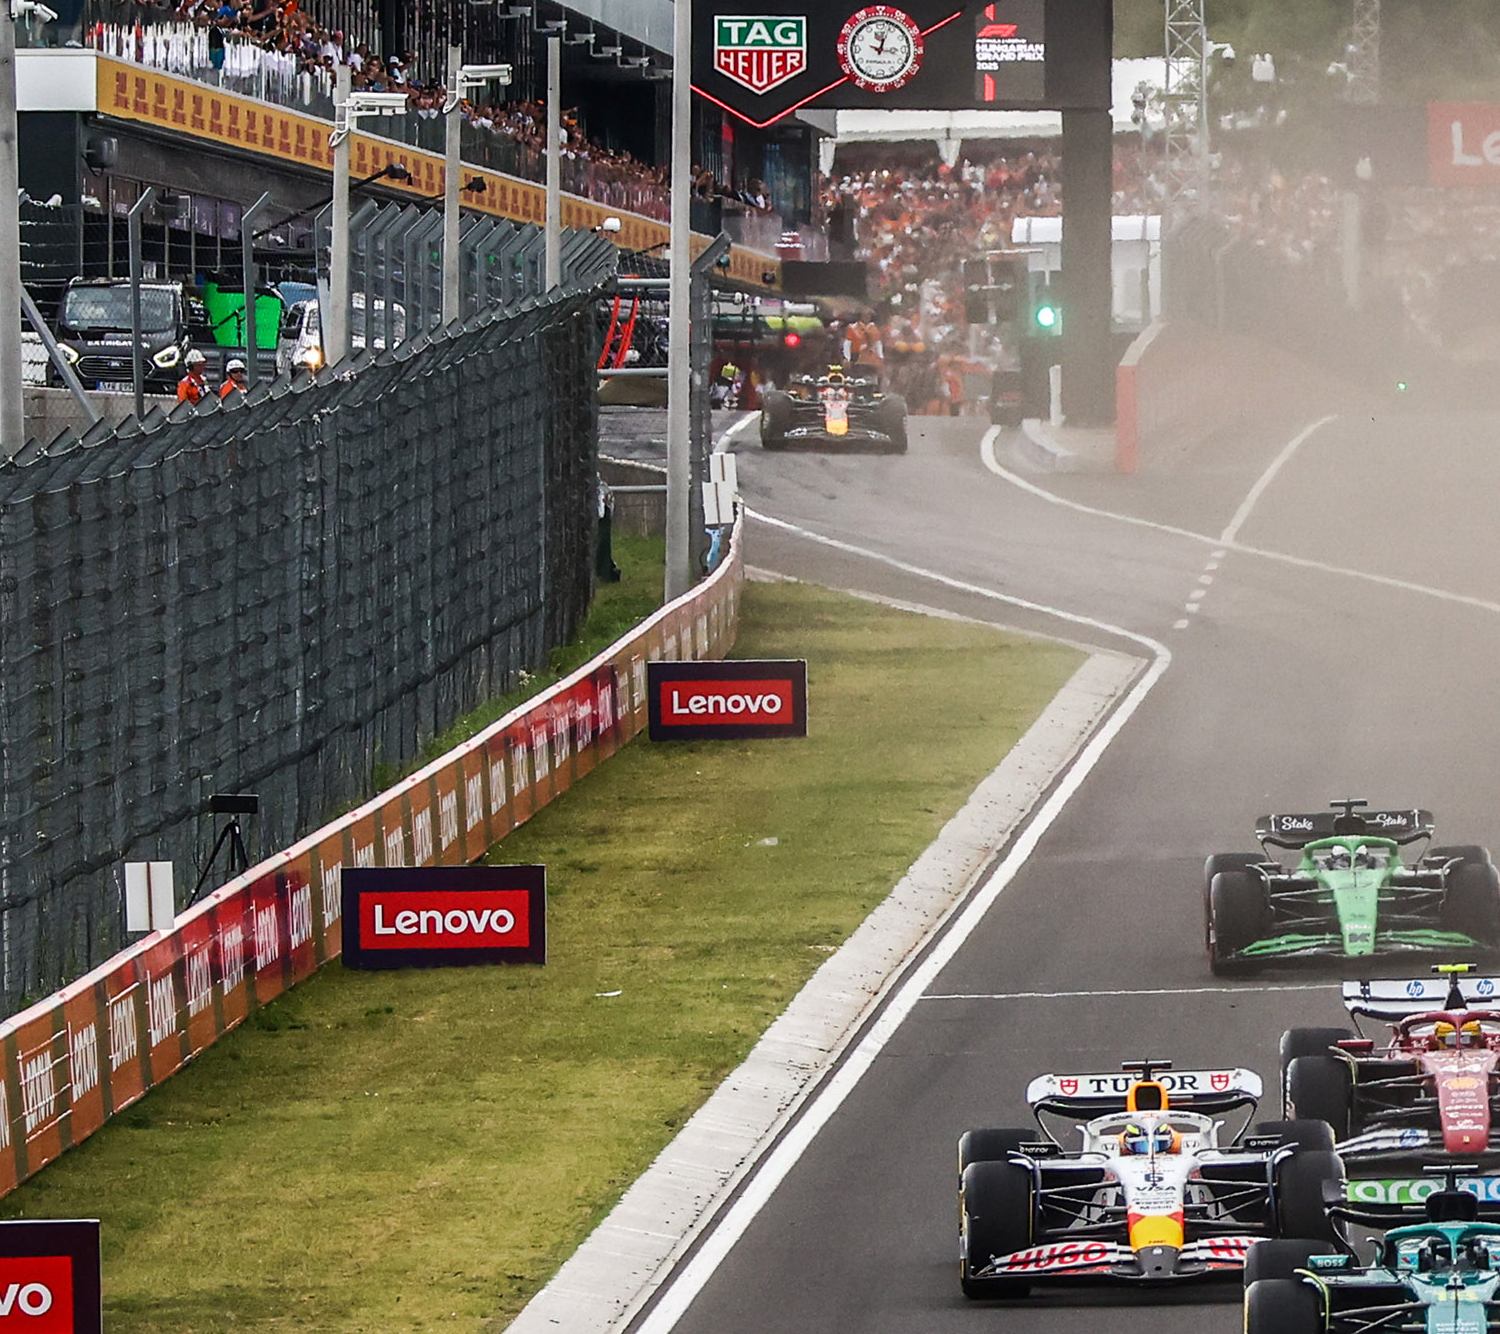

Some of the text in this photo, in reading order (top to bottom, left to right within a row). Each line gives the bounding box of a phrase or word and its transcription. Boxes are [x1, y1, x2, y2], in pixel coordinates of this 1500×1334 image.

[722, 21, 799, 45] TAG
[720, 50, 801, 90] HEUER
[672, 690, 783, 715] Lenovo
[1281, 816, 1314, 830] Stake
[1376, 813, 1408, 827] Stake
[374, 903, 515, 936] Lenovo
[67, 1021, 98, 1103] Lenovo
[1089, 1074, 1200, 1093] TUOR
[1006, 1241, 1108, 1271] HUGO
[1317, 1258, 1344, 1268] BOSS
